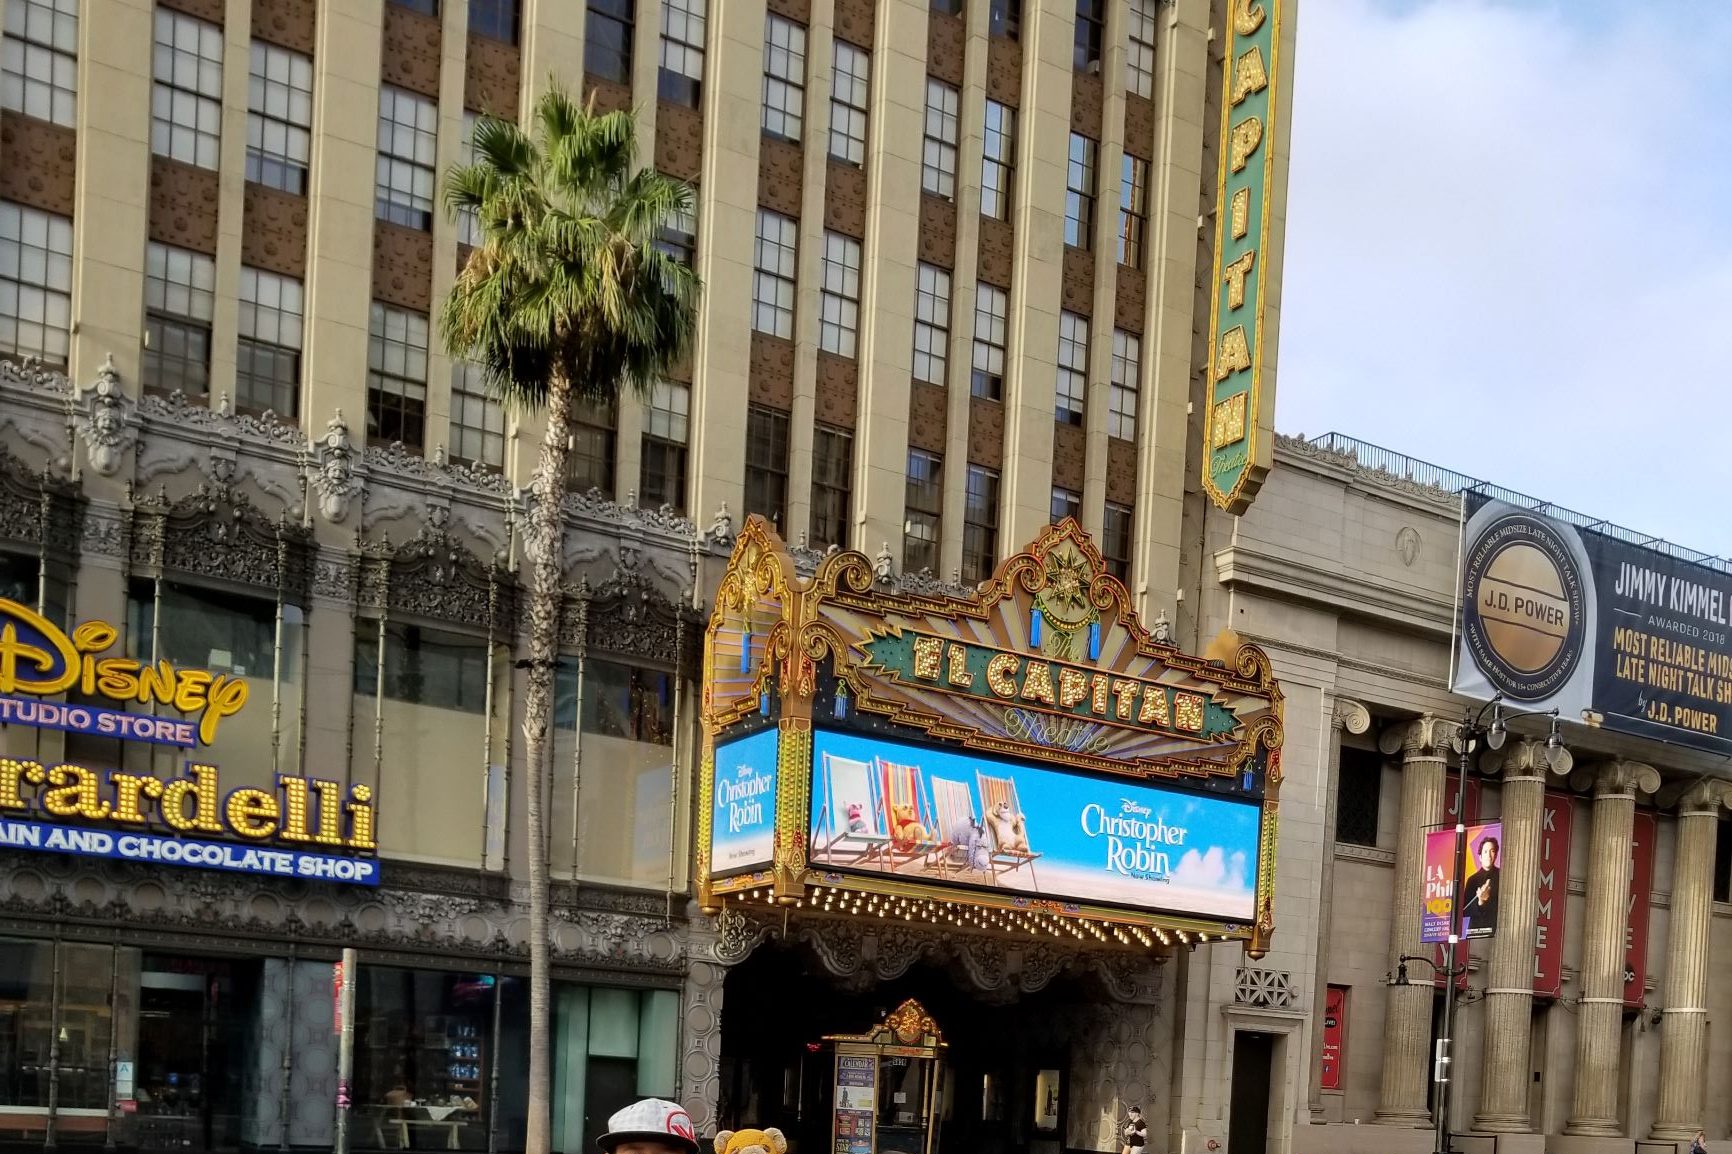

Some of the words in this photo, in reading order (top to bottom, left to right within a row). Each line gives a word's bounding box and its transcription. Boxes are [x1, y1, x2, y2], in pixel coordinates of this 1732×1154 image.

[1466, 568, 1478, 598] MOST
[1473, 532, 1502, 569] RELIABLE
[1499, 524, 1528, 538] MIDSIZE
[1528, 526, 1546, 541] LATE
[1545, 538, 1565, 563] NIGHT
[1563, 563, 1577, 590] TALK
[1484, 590, 1510, 612] J.D.
[1514, 596, 1564, 627] POWER
[1615, 561, 1667, 607] JIMMY
[1669, 577, 1726, 625] KIMMEL
[1050, 631, 1082, 663] The
[1613, 626, 1648, 657] MOST
[1650, 636, 1705, 672] RELIABLE
[1647, 615, 1699, 638] AWARDED
[1702, 629, 1726, 645] 2018
[914, 636, 974, 689] EL
[986, 653, 1205, 732] CAPITAN
[1480, 648, 1492, 668] SAME
[1492, 664, 1507, 683] HOST
[1506, 677, 1517, 689] FOR
[1517, 683, 1526, 691] 15+
[1526, 669, 1562, 691] CONSECUTIVE
[1616, 653, 1645, 683] LATE
[1648, 662, 1684, 692] NIGHT
[1686, 671, 1715, 700] TALK
[97, 712, 194, 744] STORE
[1003, 706, 1111, 752] Theatre
[1638, 690, 1648, 712] by
[1647, 700, 1671, 723] J.D.
[1674, 706, 1718, 733] POWER
[0, 758, 378, 849] rardelli
[718, 772, 772, 808] Christopher
[1120, 797, 1152, 819] Disney
[729, 799, 763, 833] Robin
[1081, 803, 1188, 849] Christopher
[44, 828, 113, 855] AND
[118, 835, 294, 875] CHOCOLATE
[296, 857, 374, 882] SHOP
[1106, 836, 1170, 877] Robin
[1426, 864, 1445, 881] LA
[1131, 872, 1143, 880] Now
[1145, 873, 1170, 884] Showing
[1425, 879, 1453, 898] Phil
[1533, 807, 1557, 978] KIMMEL
[120, 1064, 129, 1073] A
